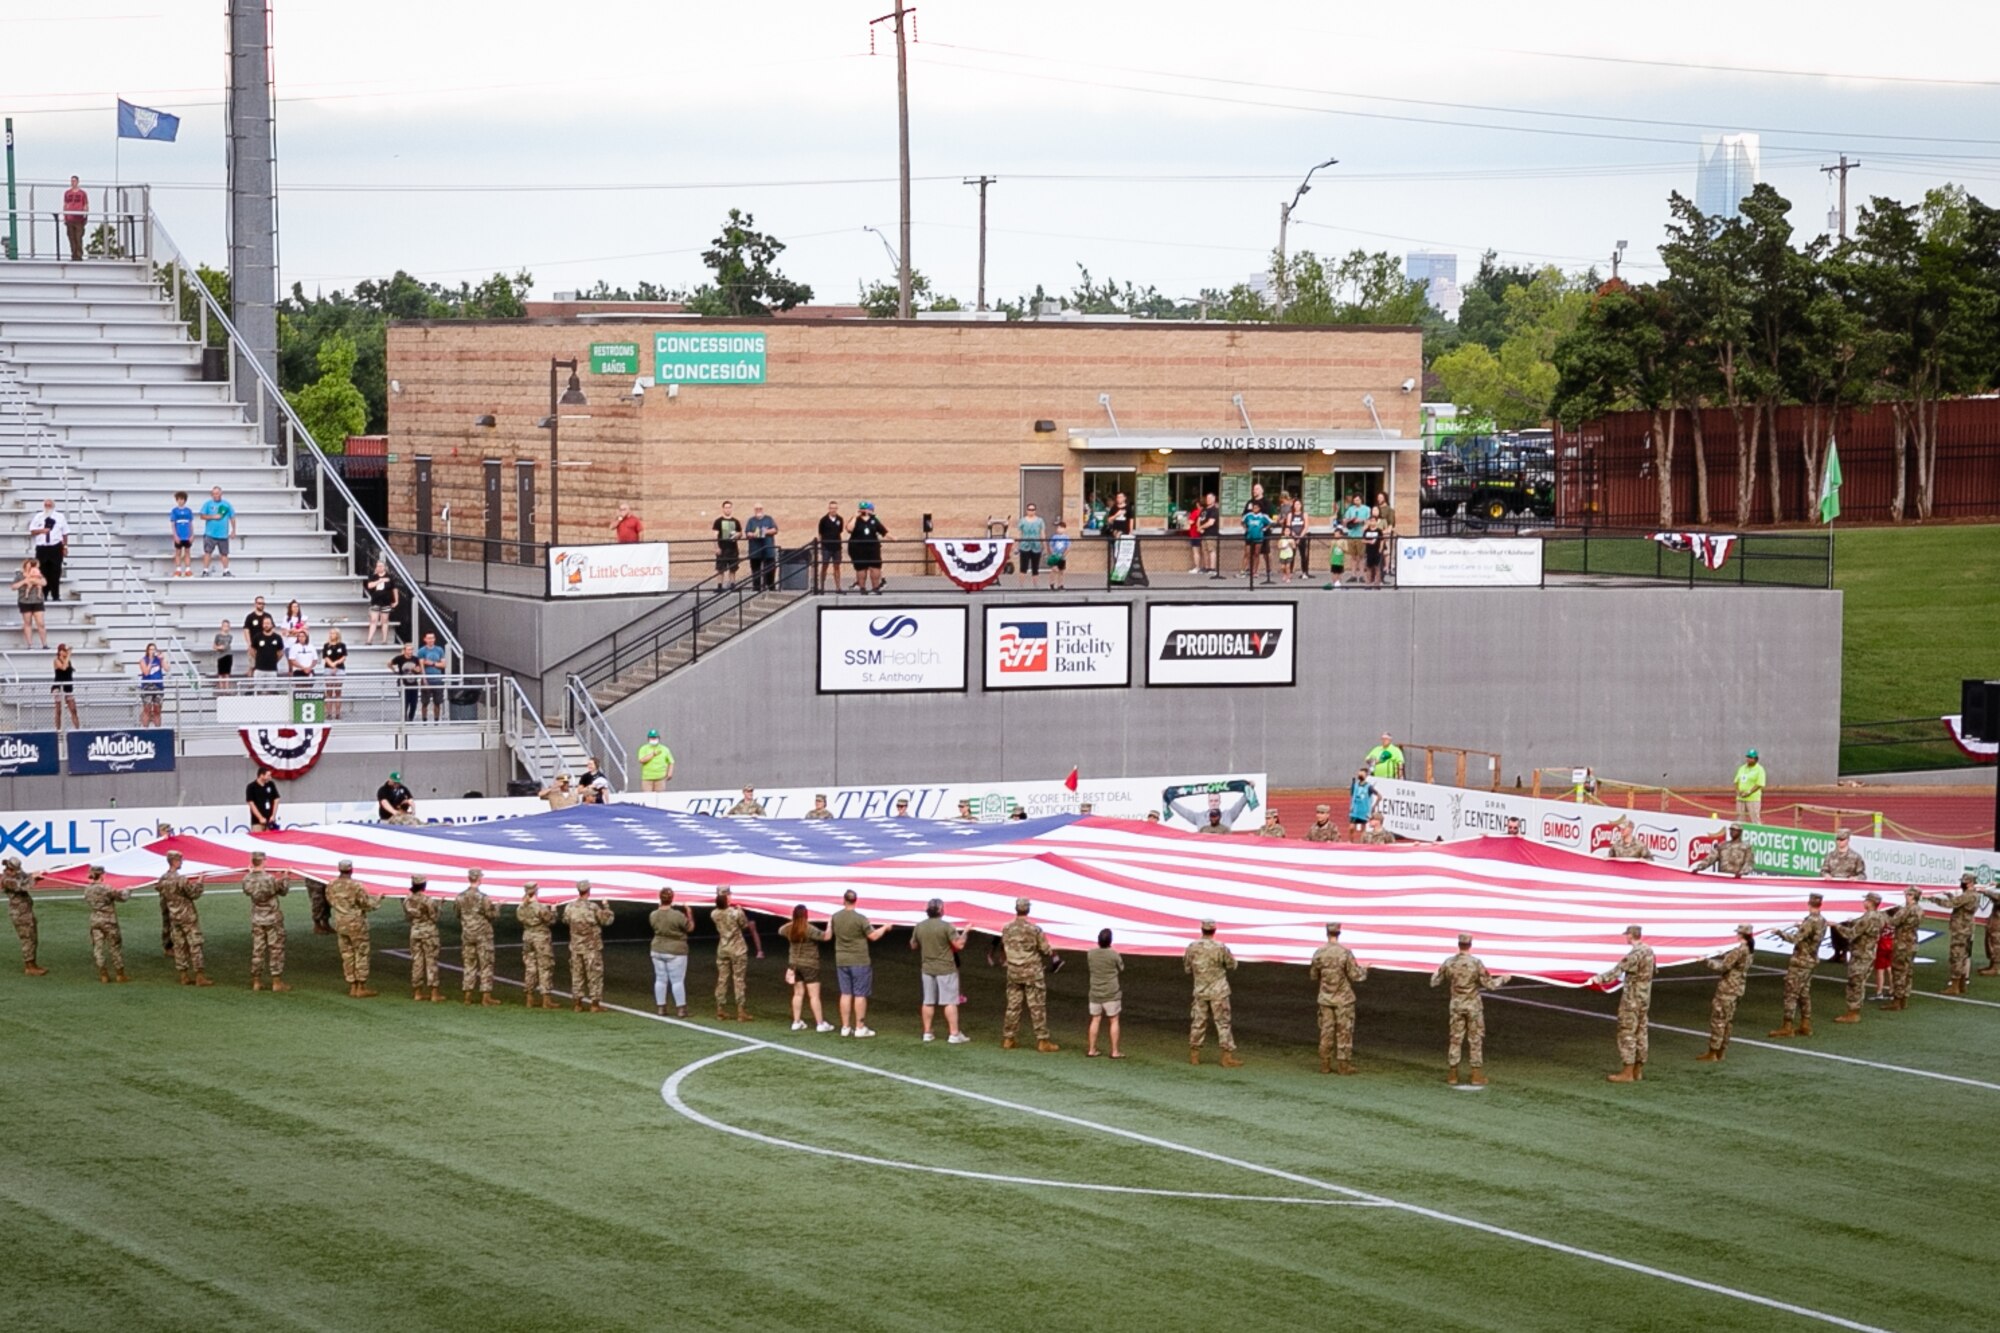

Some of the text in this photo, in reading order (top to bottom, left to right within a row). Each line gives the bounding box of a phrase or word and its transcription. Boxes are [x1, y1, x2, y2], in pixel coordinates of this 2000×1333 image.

[594, 346, 635, 357] RESTROOMS
[657, 337, 765, 353] CONCESSIONS
[602, 360, 626, 374] BAÑOS
[662, 360, 760, 380] CONCESIÓN
[1201, 437, 1316, 450] CONCESSIONS
[588, 564, 664, 579] Little Caesars
[1055, 620, 1092, 636] First
[1055, 638, 1114, 657] Fidelity
[1175, 633, 1254, 657] PRODIGAL
[1055, 657, 1096, 672] Bank
[862, 672, 924, 684] St. Anthony
[295, 692, 325, 700] SECTION
[302, 702, 316, 722] 8
[96, 735, 147, 757] Modelo
[1028, 791, 1132, 805] SCORE THE BEST DEAL
[686, 796, 788, 819] TFU
[1028, 805, 1046, 816] ON
[1544, 821, 1580, 840] BIMBO
[1742, 829, 1798, 852] PROTECT
[1754, 849, 1824, 873] NIQUE SMIL
[1864, 846, 1957, 871] Individual Dental
[1872, 866, 1902, 883] Plans
